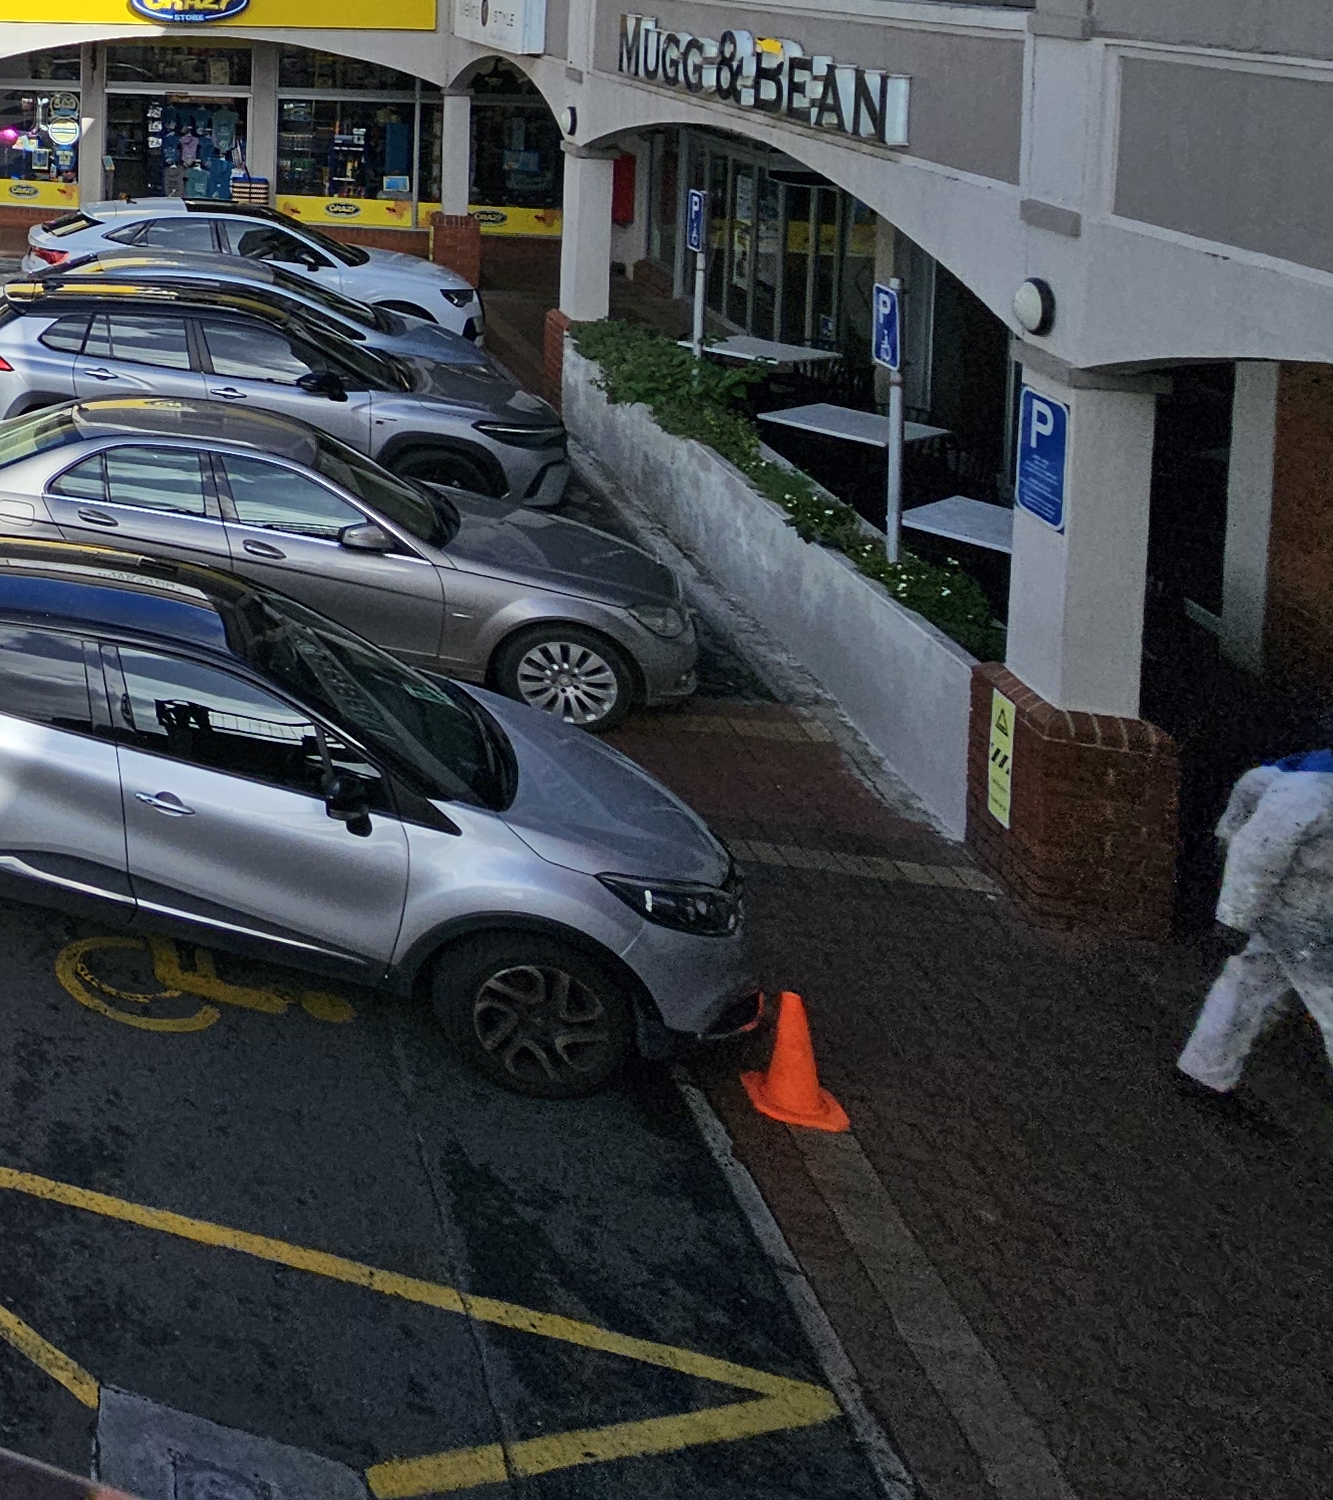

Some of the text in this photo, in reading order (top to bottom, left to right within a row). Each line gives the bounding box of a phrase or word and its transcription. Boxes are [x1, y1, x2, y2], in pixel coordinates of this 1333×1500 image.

[618, 13, 706, 93] MUGG
[755, 42, 906, 145] BEAN
[692, 195, 700, 219] P
[879, 293, 891, 323] P
[1030, 398, 1054, 448] P
